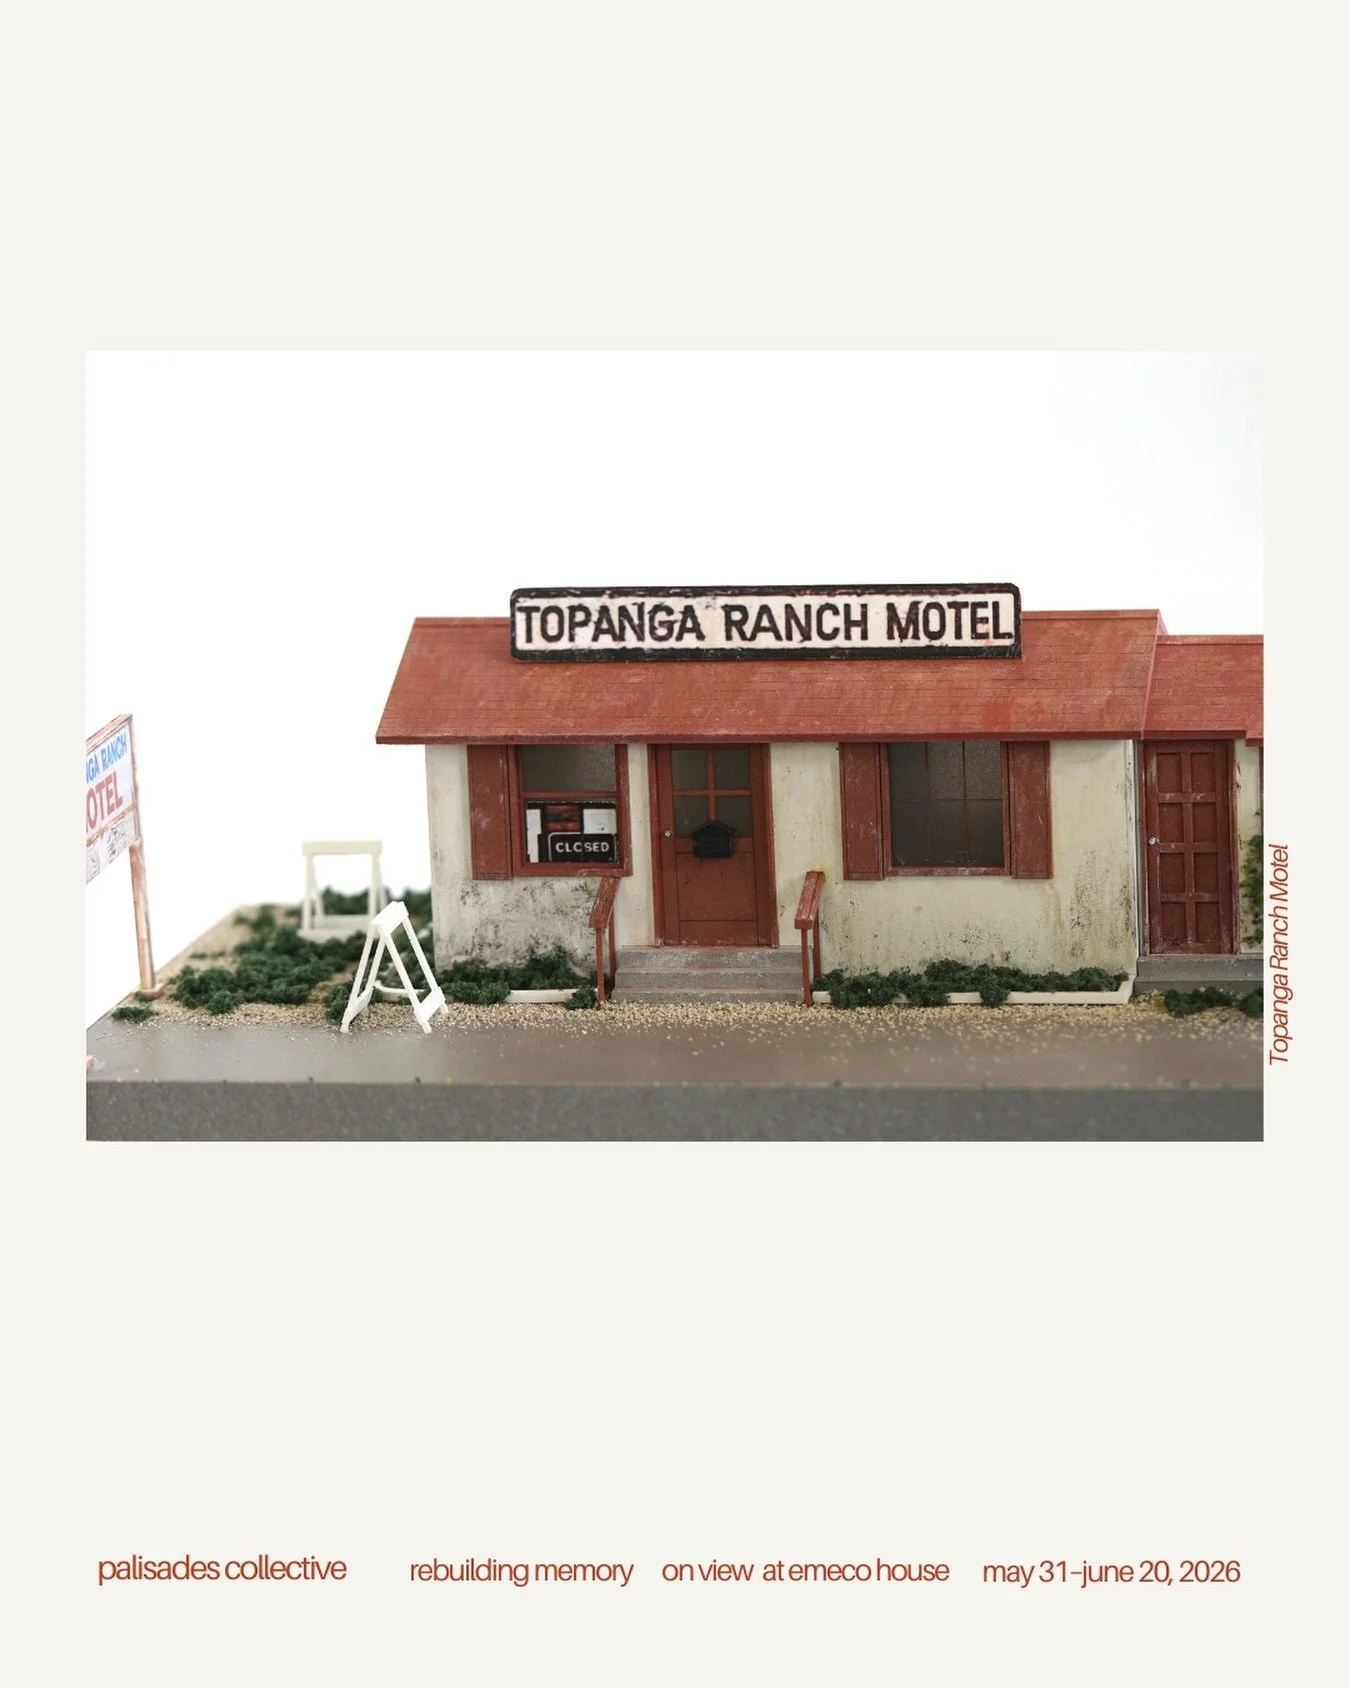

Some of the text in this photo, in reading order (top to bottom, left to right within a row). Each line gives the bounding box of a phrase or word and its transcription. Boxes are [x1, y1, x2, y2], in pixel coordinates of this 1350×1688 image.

[517, 600, 1014, 643] TOPANGA RANCH MOTEL
[101, 731, 127, 771] RANCH
[86, 770, 123, 834] OTEL
[555, 842, 610, 853] CLOSED
